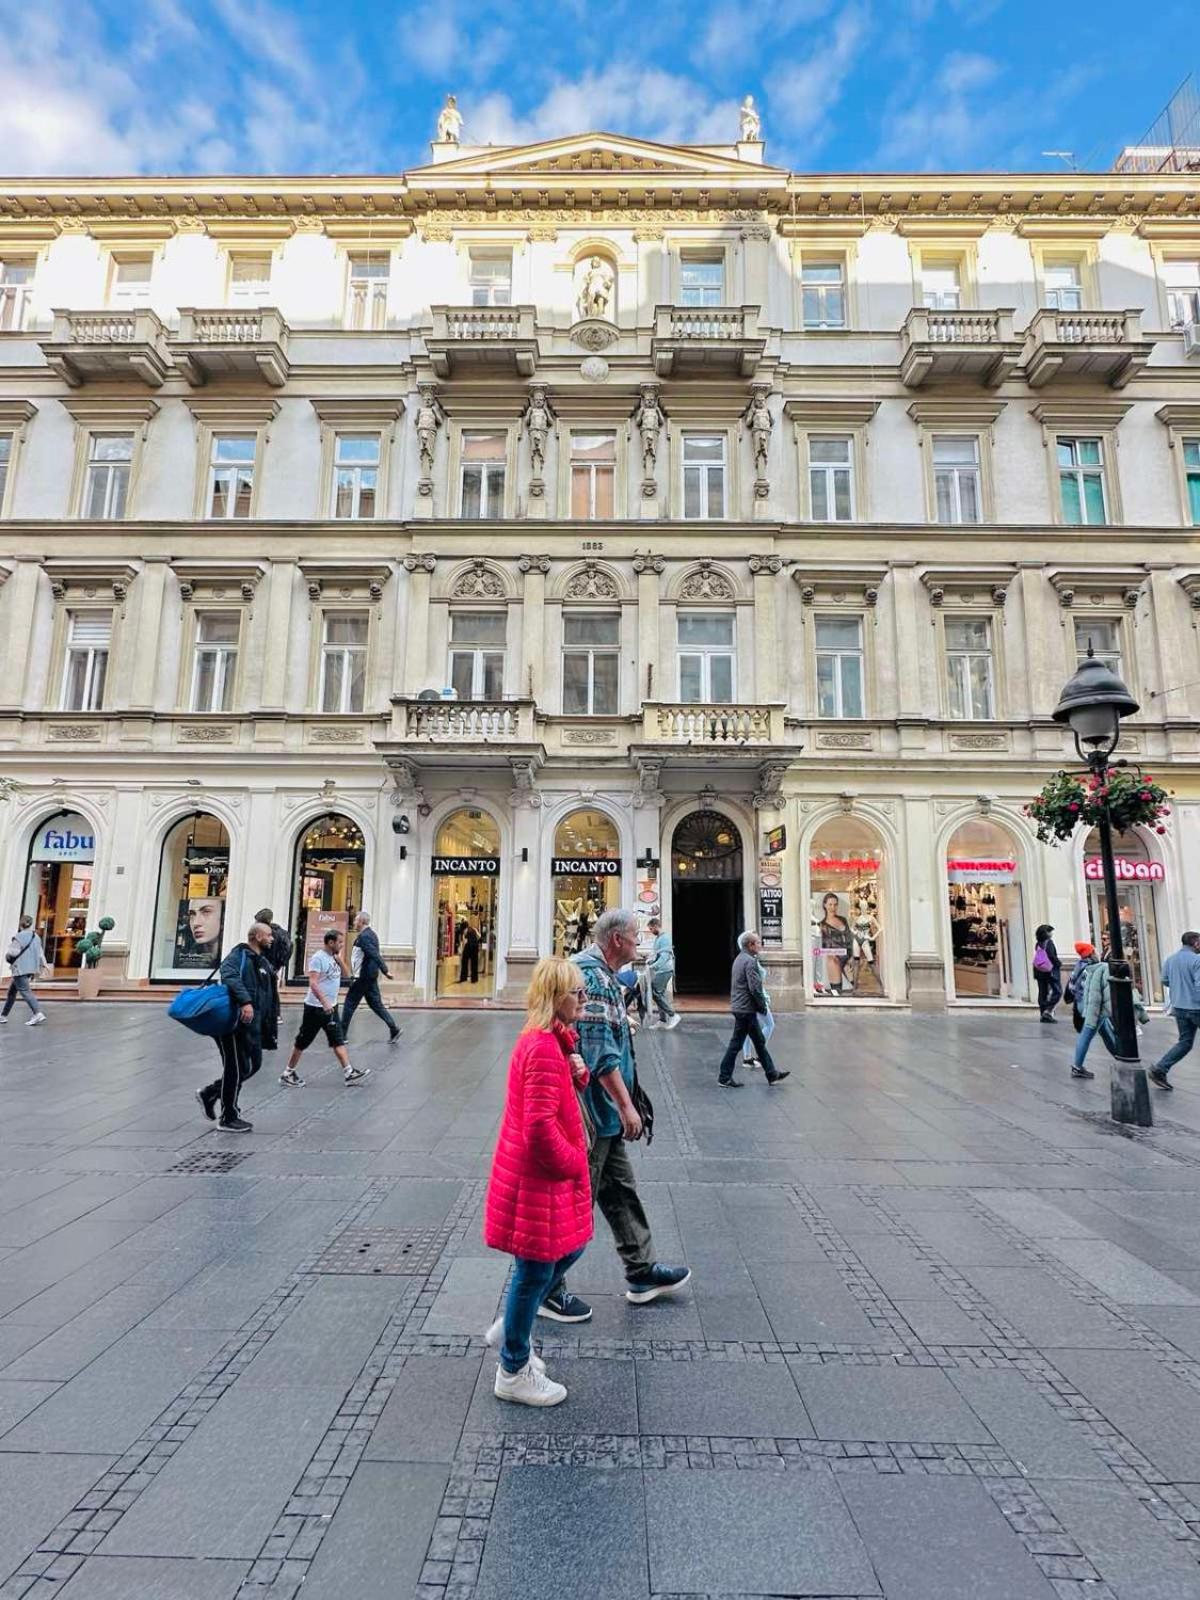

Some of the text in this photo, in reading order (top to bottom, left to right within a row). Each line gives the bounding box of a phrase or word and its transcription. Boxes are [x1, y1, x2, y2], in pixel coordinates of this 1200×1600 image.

[43, 830, 94, 849] fabu
[434, 859, 497, 872] INCANTO
[554, 861, 618, 873] INCANTO
[1086, 859, 1163, 878] ciiban
[760, 889, 782, 898] TATTOO
